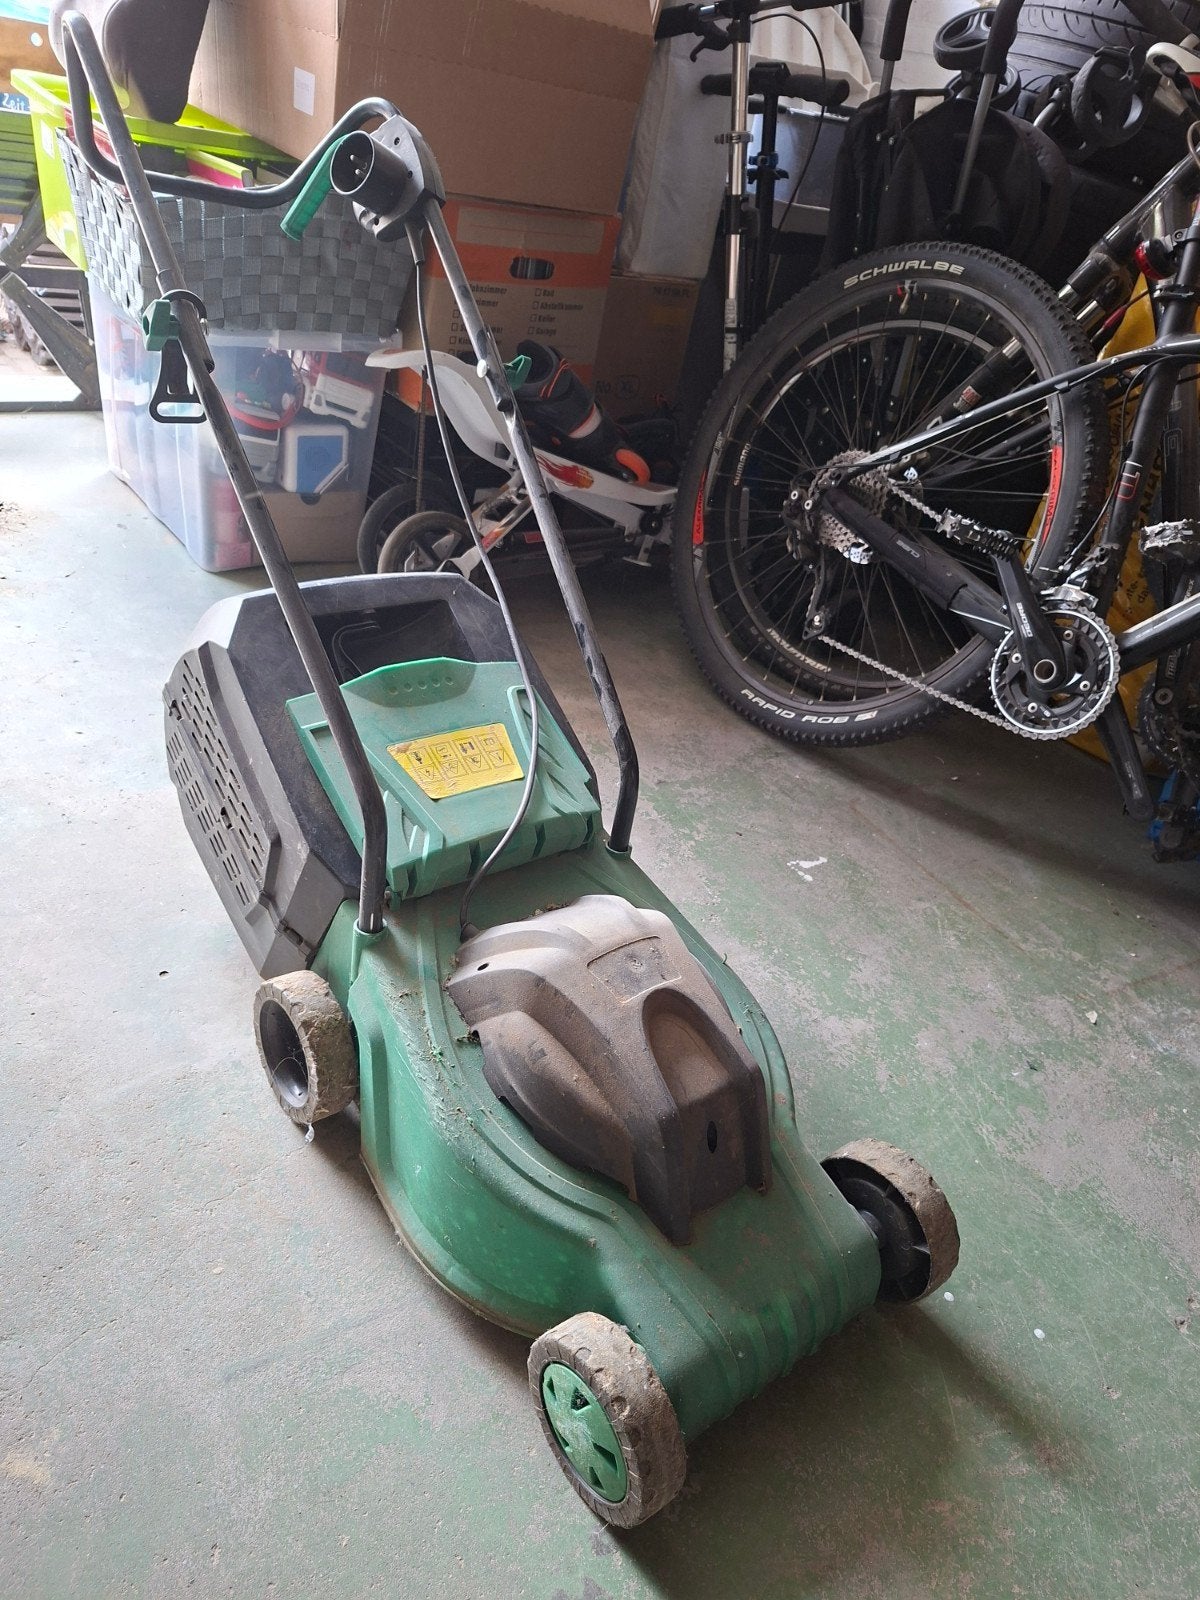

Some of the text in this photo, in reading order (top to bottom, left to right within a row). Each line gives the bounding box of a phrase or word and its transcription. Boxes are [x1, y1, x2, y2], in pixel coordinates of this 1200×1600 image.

[843, 260, 965, 289] SCHWALBE
[896, 540, 920, 558] CUBE
[1016, 602, 1033, 637] DEORE
[741, 688, 850, 724] RAPID ROB
